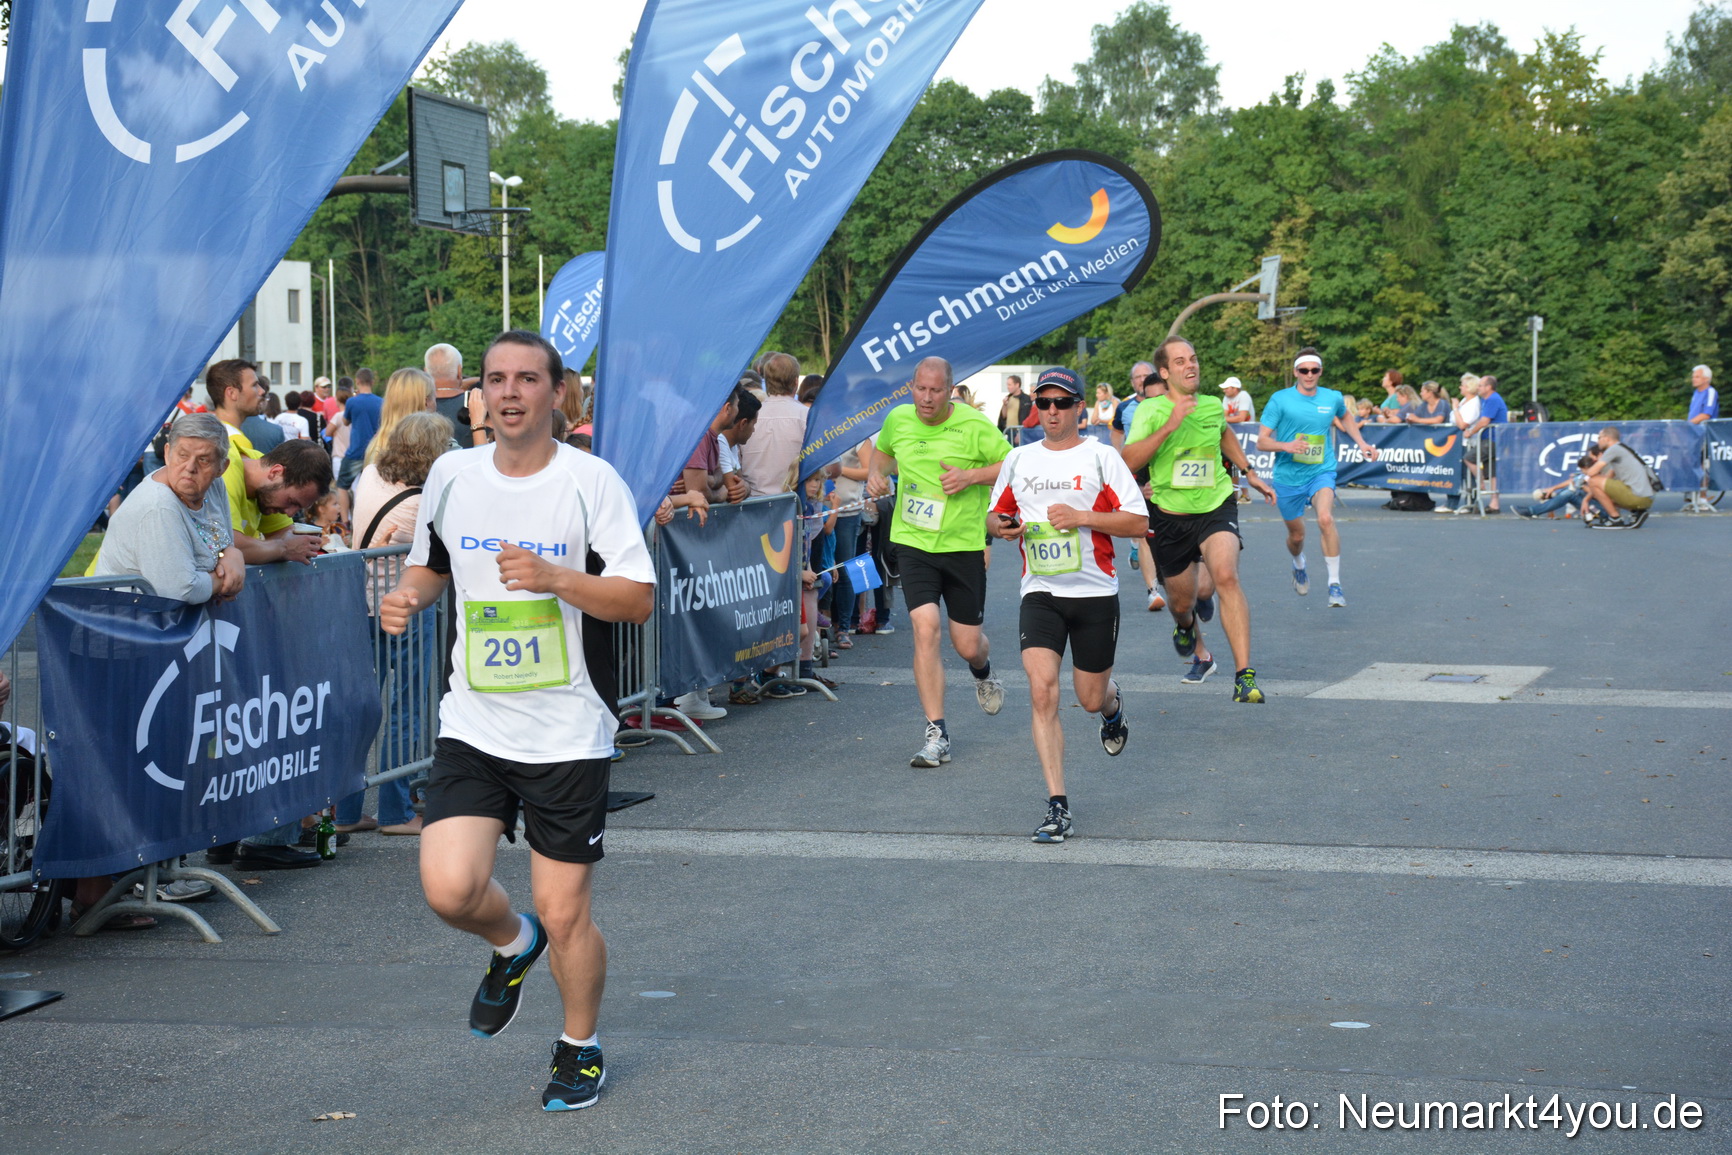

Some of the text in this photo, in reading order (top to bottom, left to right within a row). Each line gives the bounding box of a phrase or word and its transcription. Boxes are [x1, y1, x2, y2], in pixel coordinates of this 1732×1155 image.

[996, 237, 1140, 322] Druck und Medien
[861, 249, 1069, 373] Frischmann
[1181, 463, 1207, 477] 221
[1385, 463, 1410, 474] Druck
[1021, 475, 1083, 495] Xplus1
[907, 498, 934, 518] 274
[461, 536, 567, 556] DEPHI
[1030, 541, 1072, 560] 1601
[670, 560, 770, 615] Frischmann
[734, 604, 758, 631] Druck
[757, 600, 773, 625] und
[484, 636, 541, 667] 291
[187, 674, 331, 765] Fischer
[199, 745, 321, 806] AUTOMOBILE
